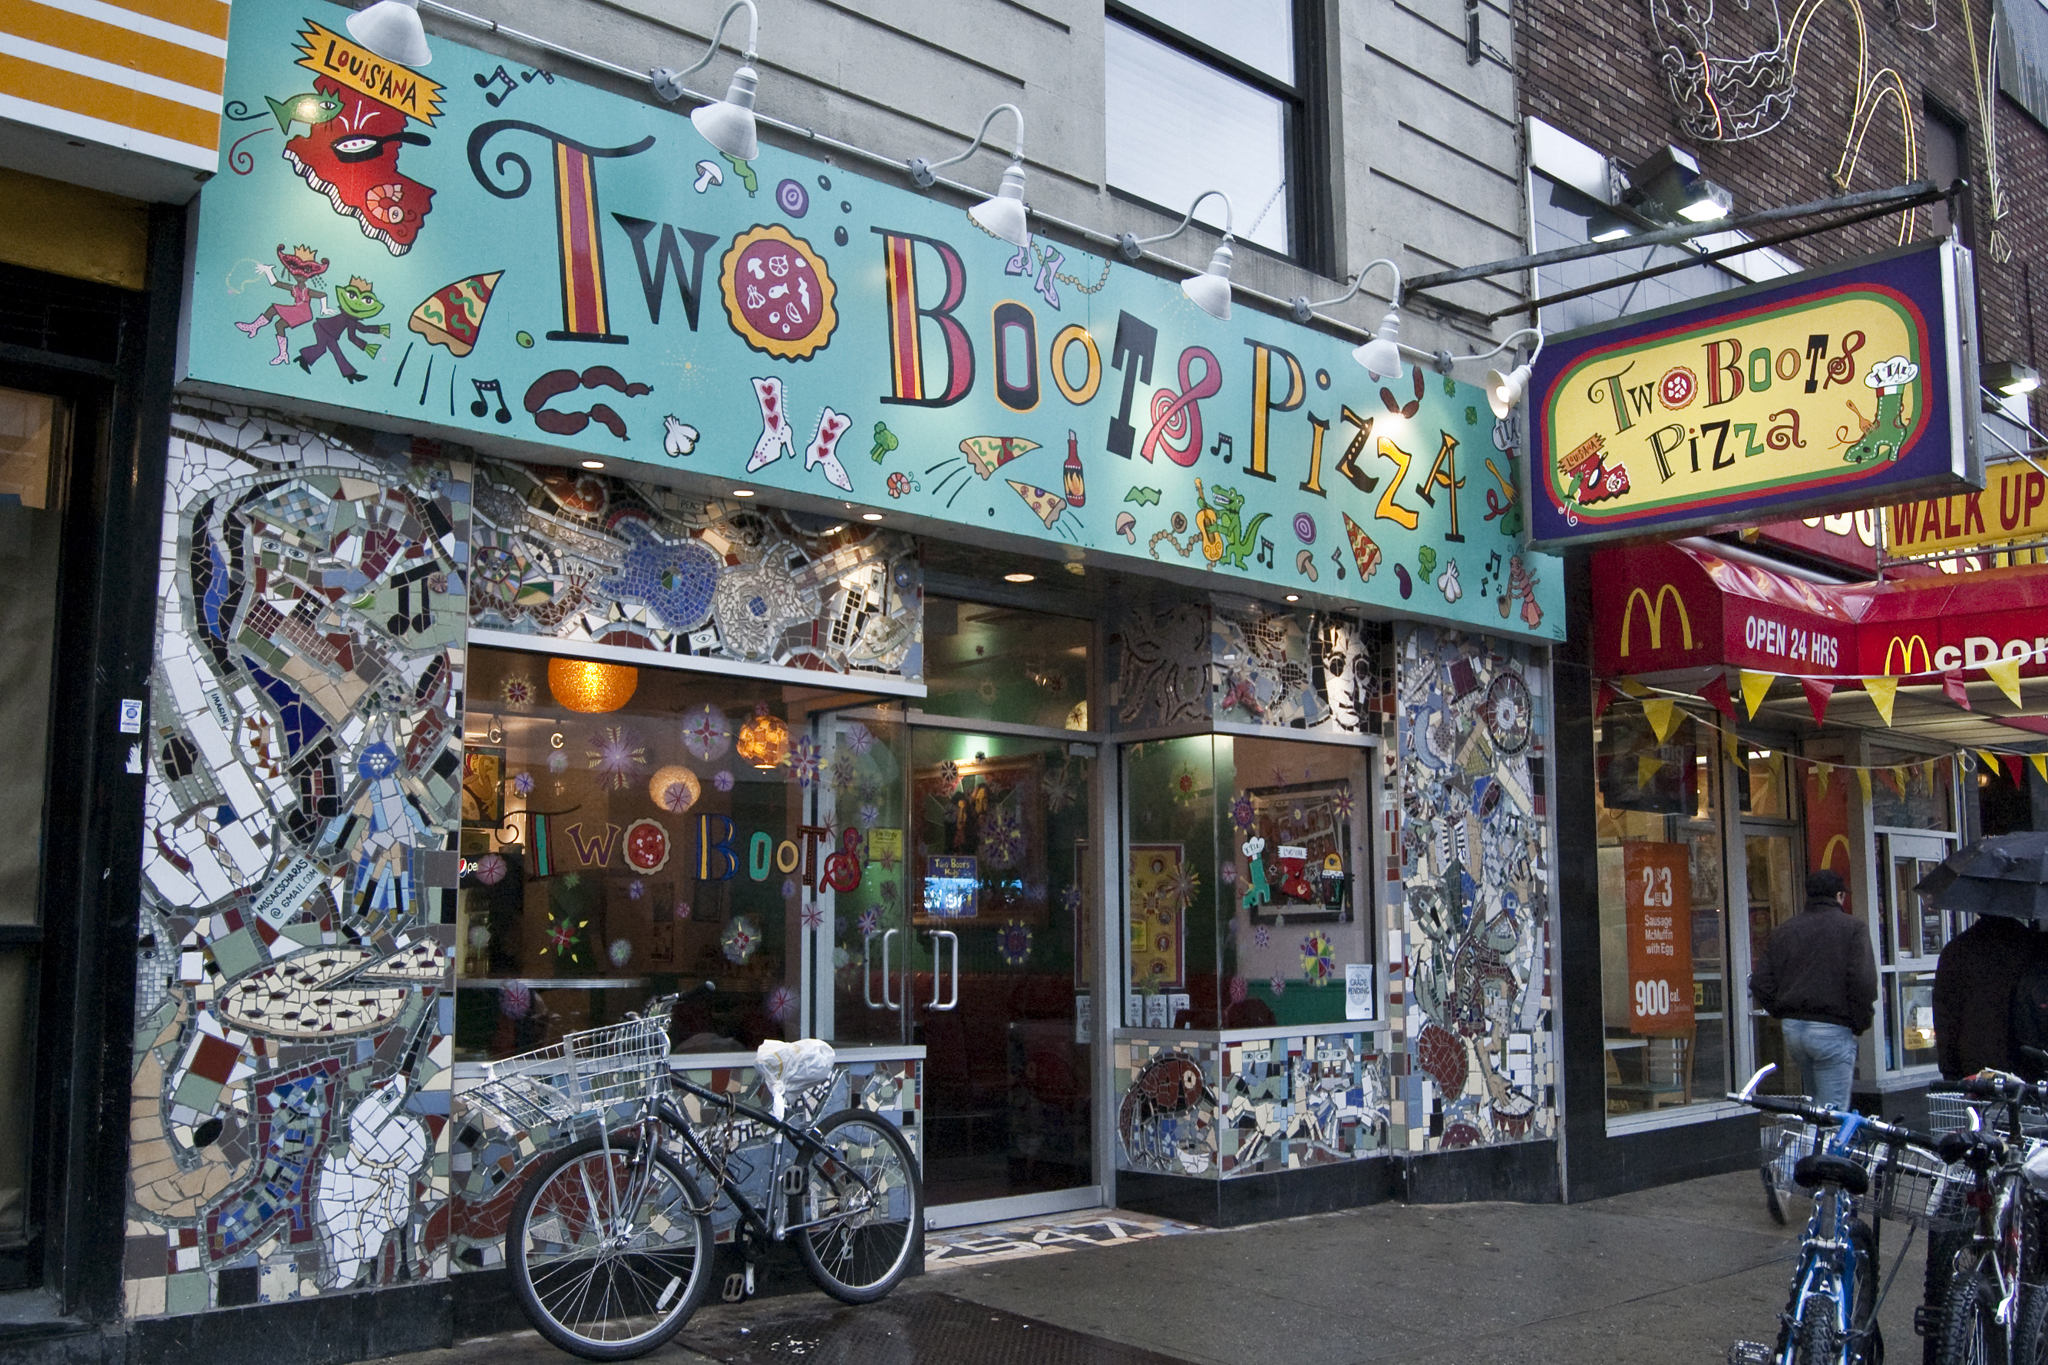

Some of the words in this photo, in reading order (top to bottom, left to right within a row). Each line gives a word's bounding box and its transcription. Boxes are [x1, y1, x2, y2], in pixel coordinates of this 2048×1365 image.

[1893, 490, 1986, 547] WALK
[2000, 472, 2046, 531] UP
[1745, 616, 1788, 657] OPEN
[1790, 628, 1807, 662] 24
[1811, 632, 1838, 669] HRS
[210, 693, 230, 723] IMAGINE
[1645, 914, 1673, 928] Sausage
[1645, 929, 1674, 940] McMuffin
[1646, 943, 1660, 954] with
[1661, 943, 1674, 956] Egg
[1635, 980, 1670, 1017] 900
